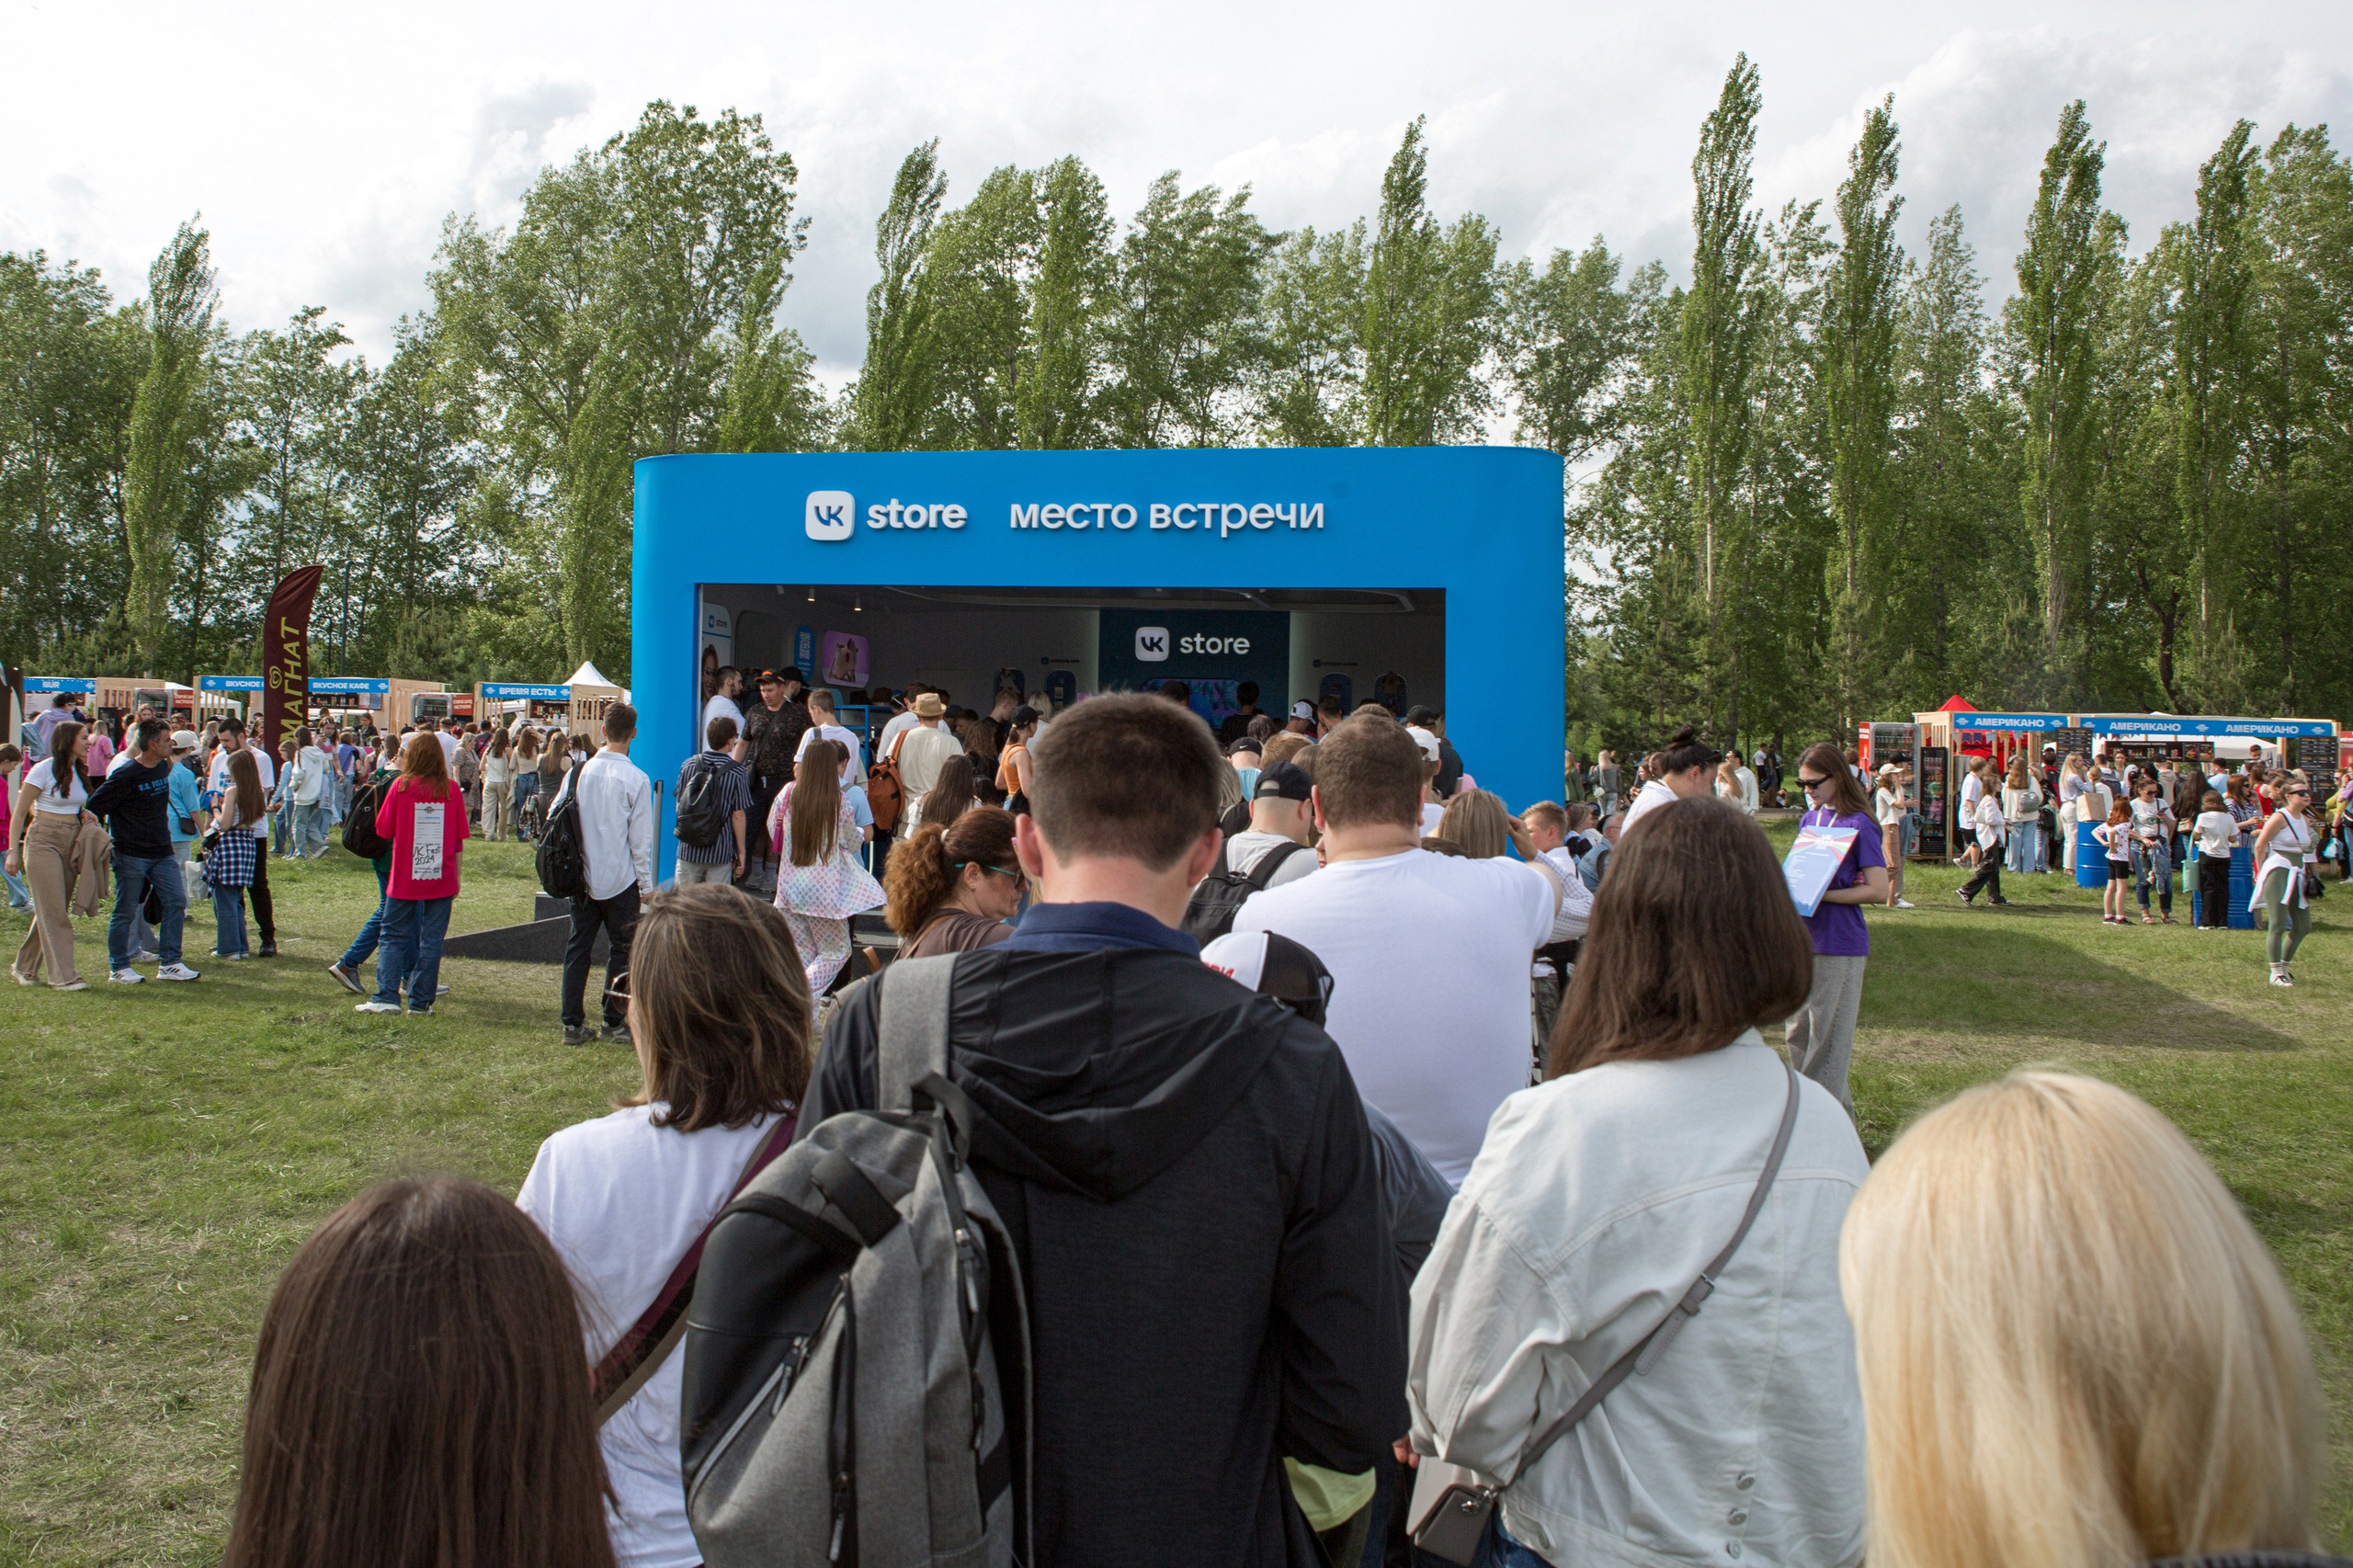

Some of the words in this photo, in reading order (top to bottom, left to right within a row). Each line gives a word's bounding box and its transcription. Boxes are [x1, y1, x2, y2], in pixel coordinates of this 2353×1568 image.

[867, 498, 968, 530] store
[1010, 502, 1139, 530] место
[1149, 502, 1325, 539] встречи
[1179, 632, 1251, 655] store
[278, 616, 303, 744] МАГНАТ
[348, 682, 369, 690] КАФЕ
[498, 687, 529, 696] ВРЕМЯ
[530, 687, 557, 697] ЕСТЬ!
[1974, 717, 2046, 728] АМЕРИКАНО
[2109, 722, 2182, 733] АМЕРИКАНО
[2224, 724, 2300, 734] АМЕРИКАНО
[426, 843, 441, 855] Fest
[414, 855, 436, 866] 2024
